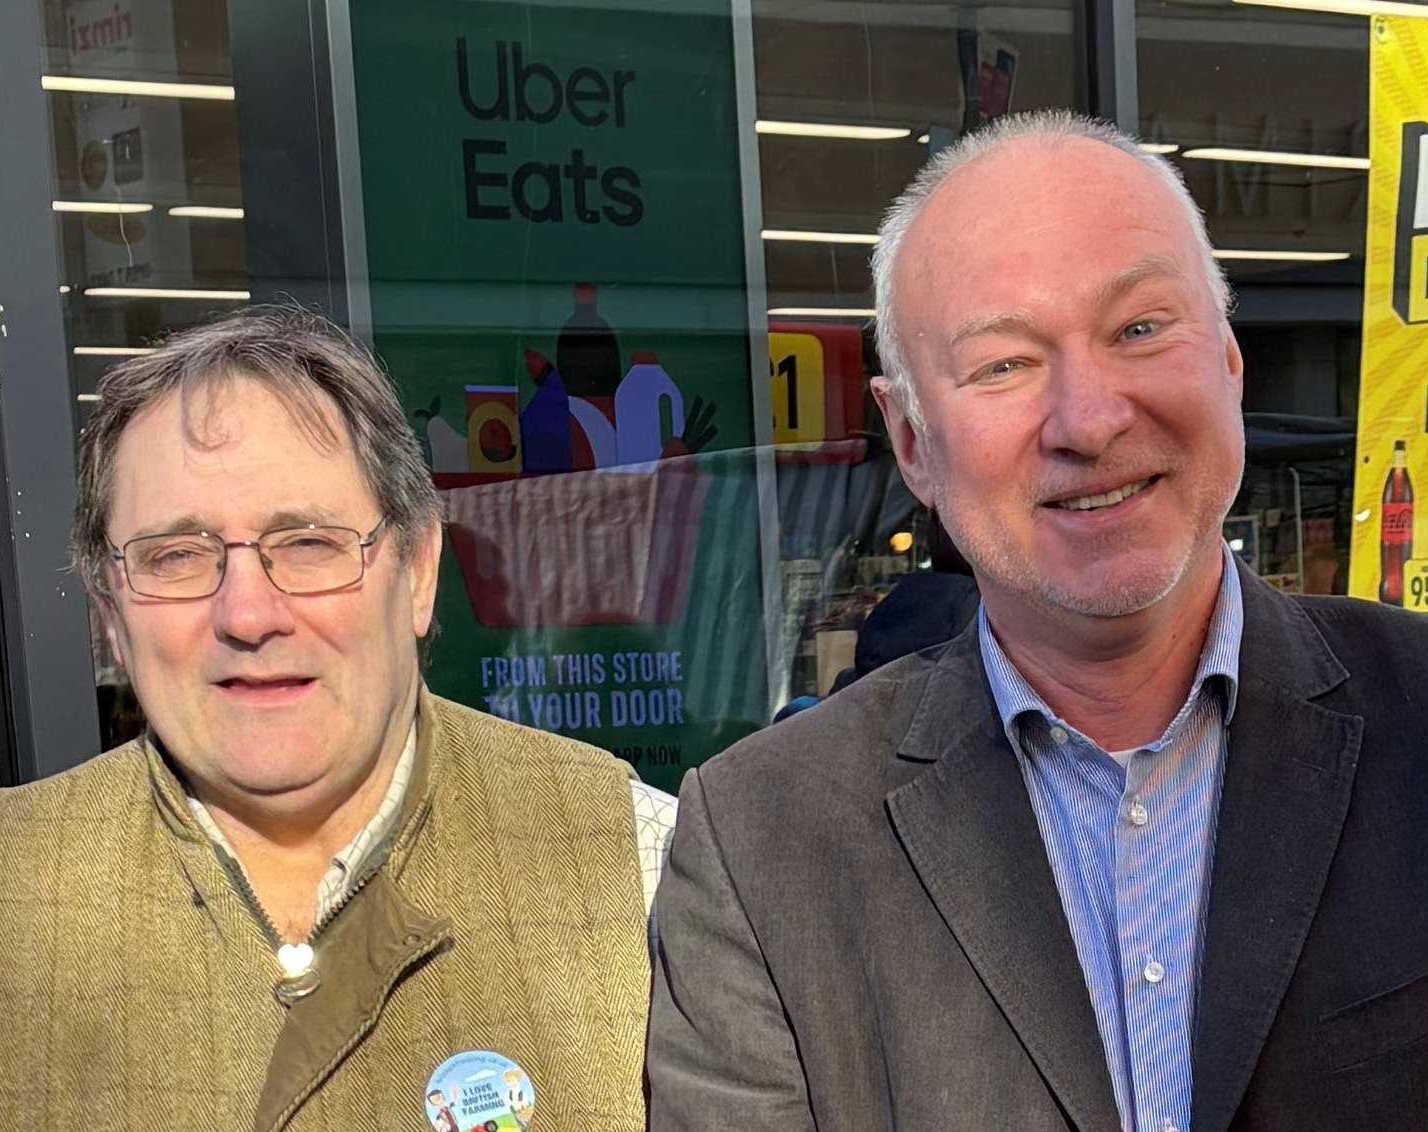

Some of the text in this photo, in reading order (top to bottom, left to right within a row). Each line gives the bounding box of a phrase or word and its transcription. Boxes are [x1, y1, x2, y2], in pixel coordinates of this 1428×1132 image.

[456, 37, 637, 128] Uber
[461, 138, 645, 226] Eats
[480, 651, 684, 688] FROM THIS STORE
[527, 690, 602, 731] YOUR
[611, 688, 684, 728] DOOR
